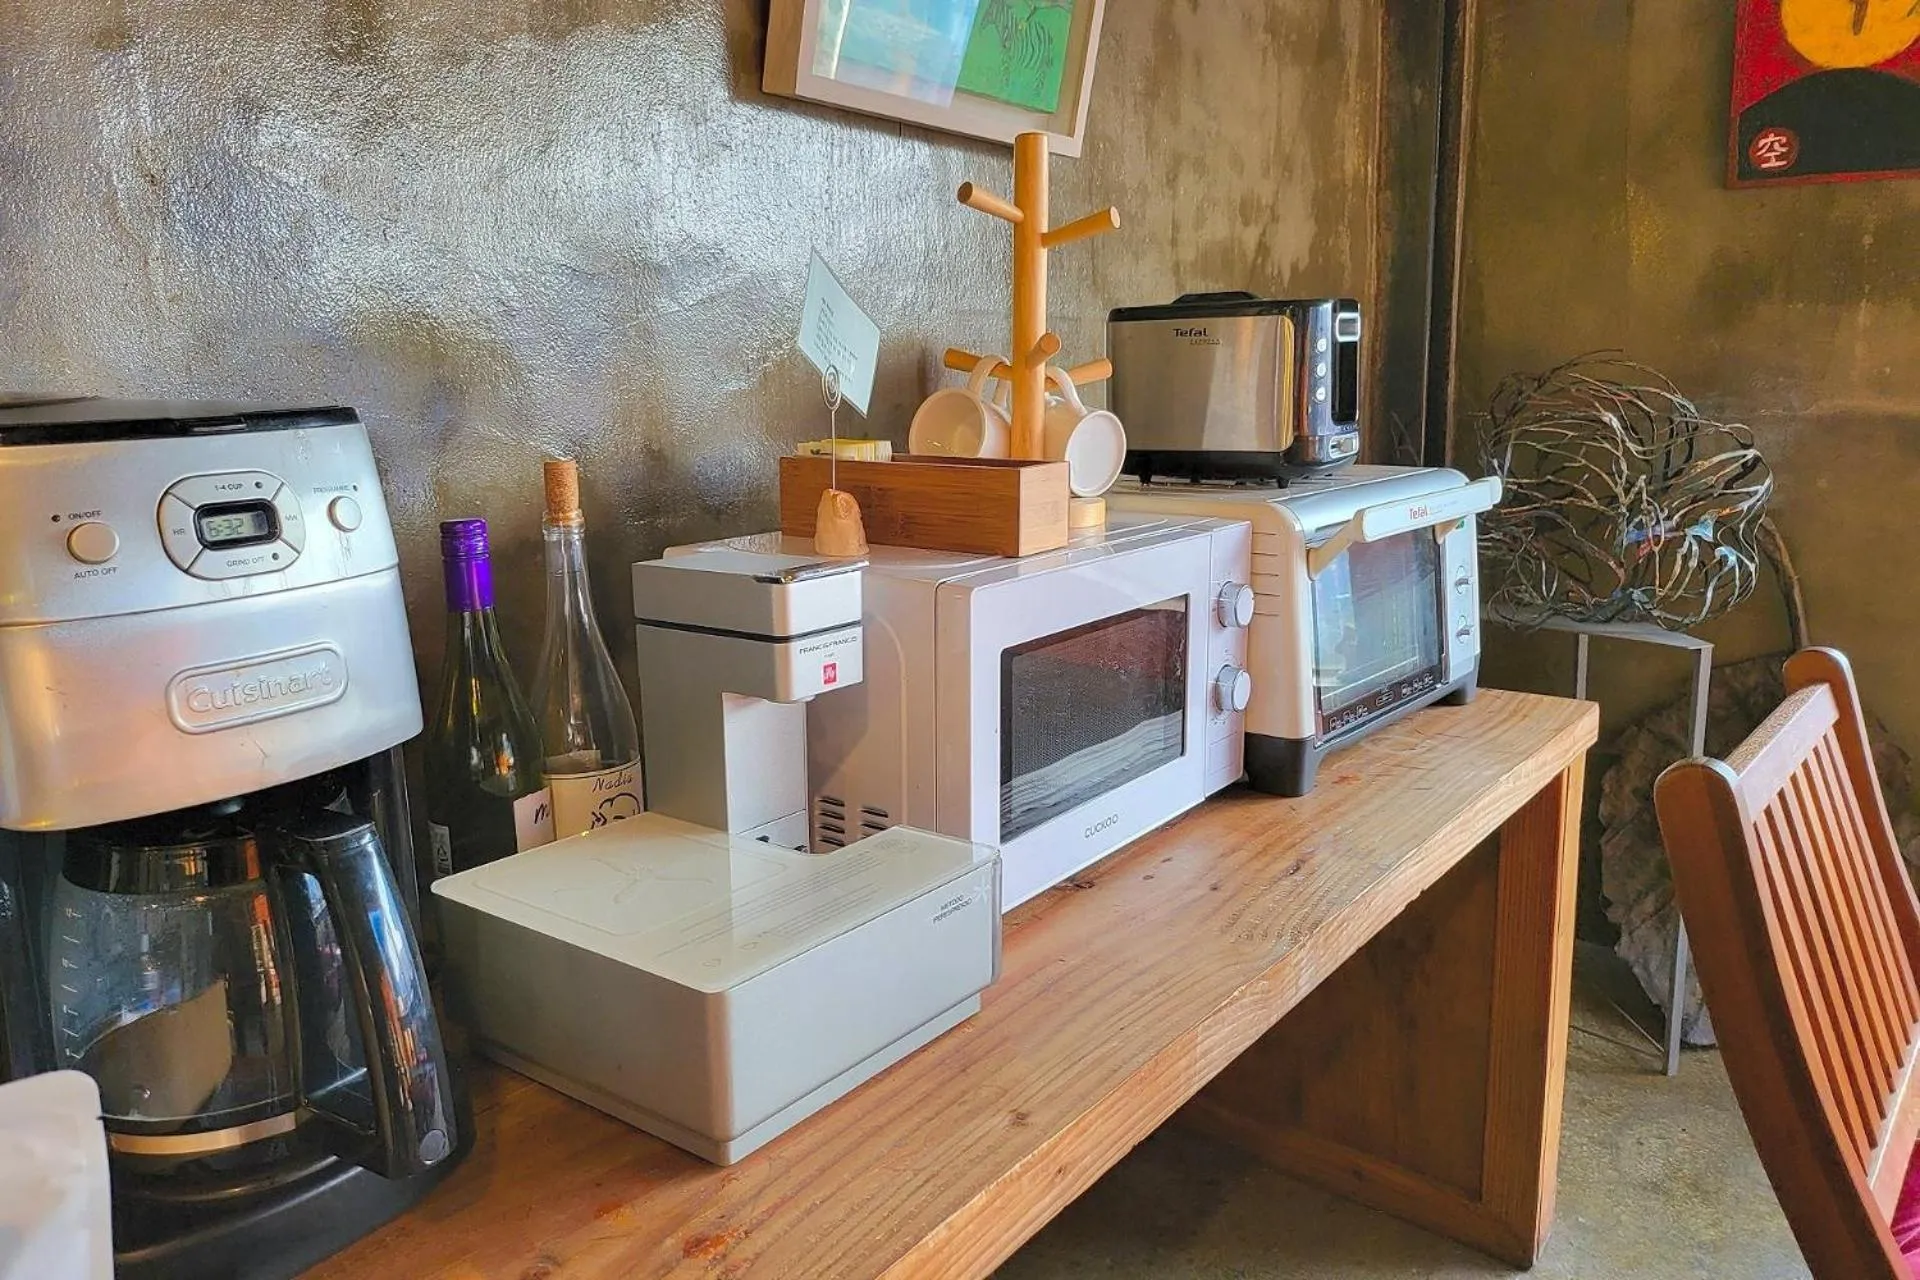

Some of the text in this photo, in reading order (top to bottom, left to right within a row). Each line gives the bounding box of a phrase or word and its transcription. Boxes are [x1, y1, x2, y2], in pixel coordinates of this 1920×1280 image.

[1756, 132, 1789, 169] 空
[1172, 327, 1209, 337] Tefal
[68, 510, 102, 520] ON/OFF
[1409, 504, 1428, 520] Tefal
[173, 527, 185, 536] HR
[205, 518, 244, 537] 6:32
[226, 559, 250, 567] GRIND
[73, 567, 118, 579] AUTO OFF
[187, 660, 334, 713] Cuisinart
